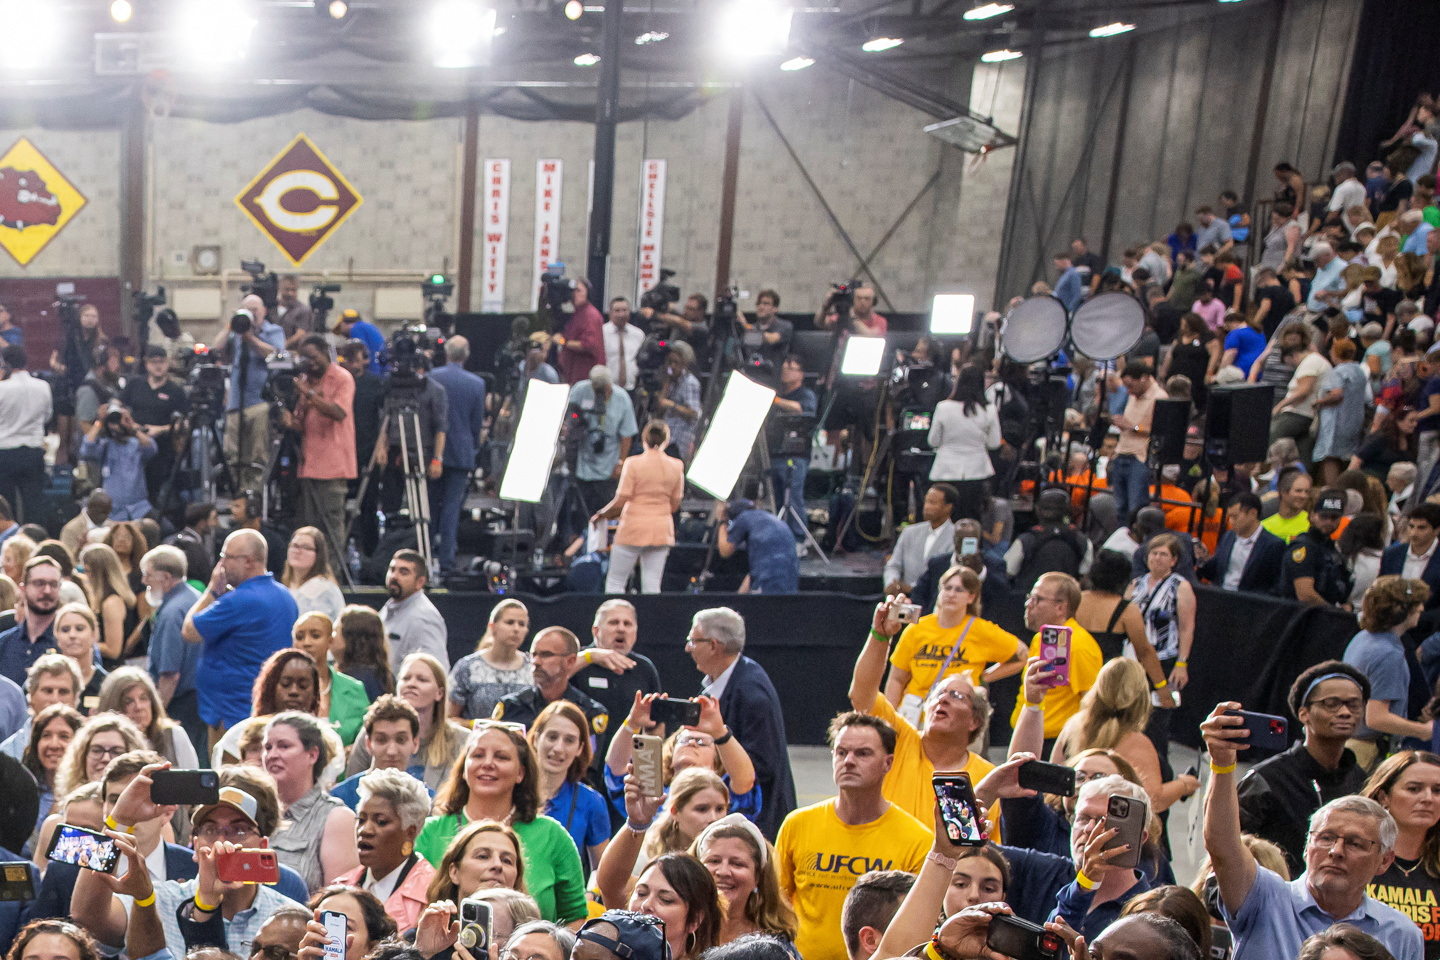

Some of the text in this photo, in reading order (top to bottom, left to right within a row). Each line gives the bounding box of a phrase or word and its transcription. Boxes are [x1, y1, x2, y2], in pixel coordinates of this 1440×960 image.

[254, 169, 340, 232] C
[543, 163, 556, 211] MIKE
[487, 163, 502, 293] CHRIS WITTY
[816, 852, 893, 875] UFCW
[1366, 883, 1438, 907] KAMALA
